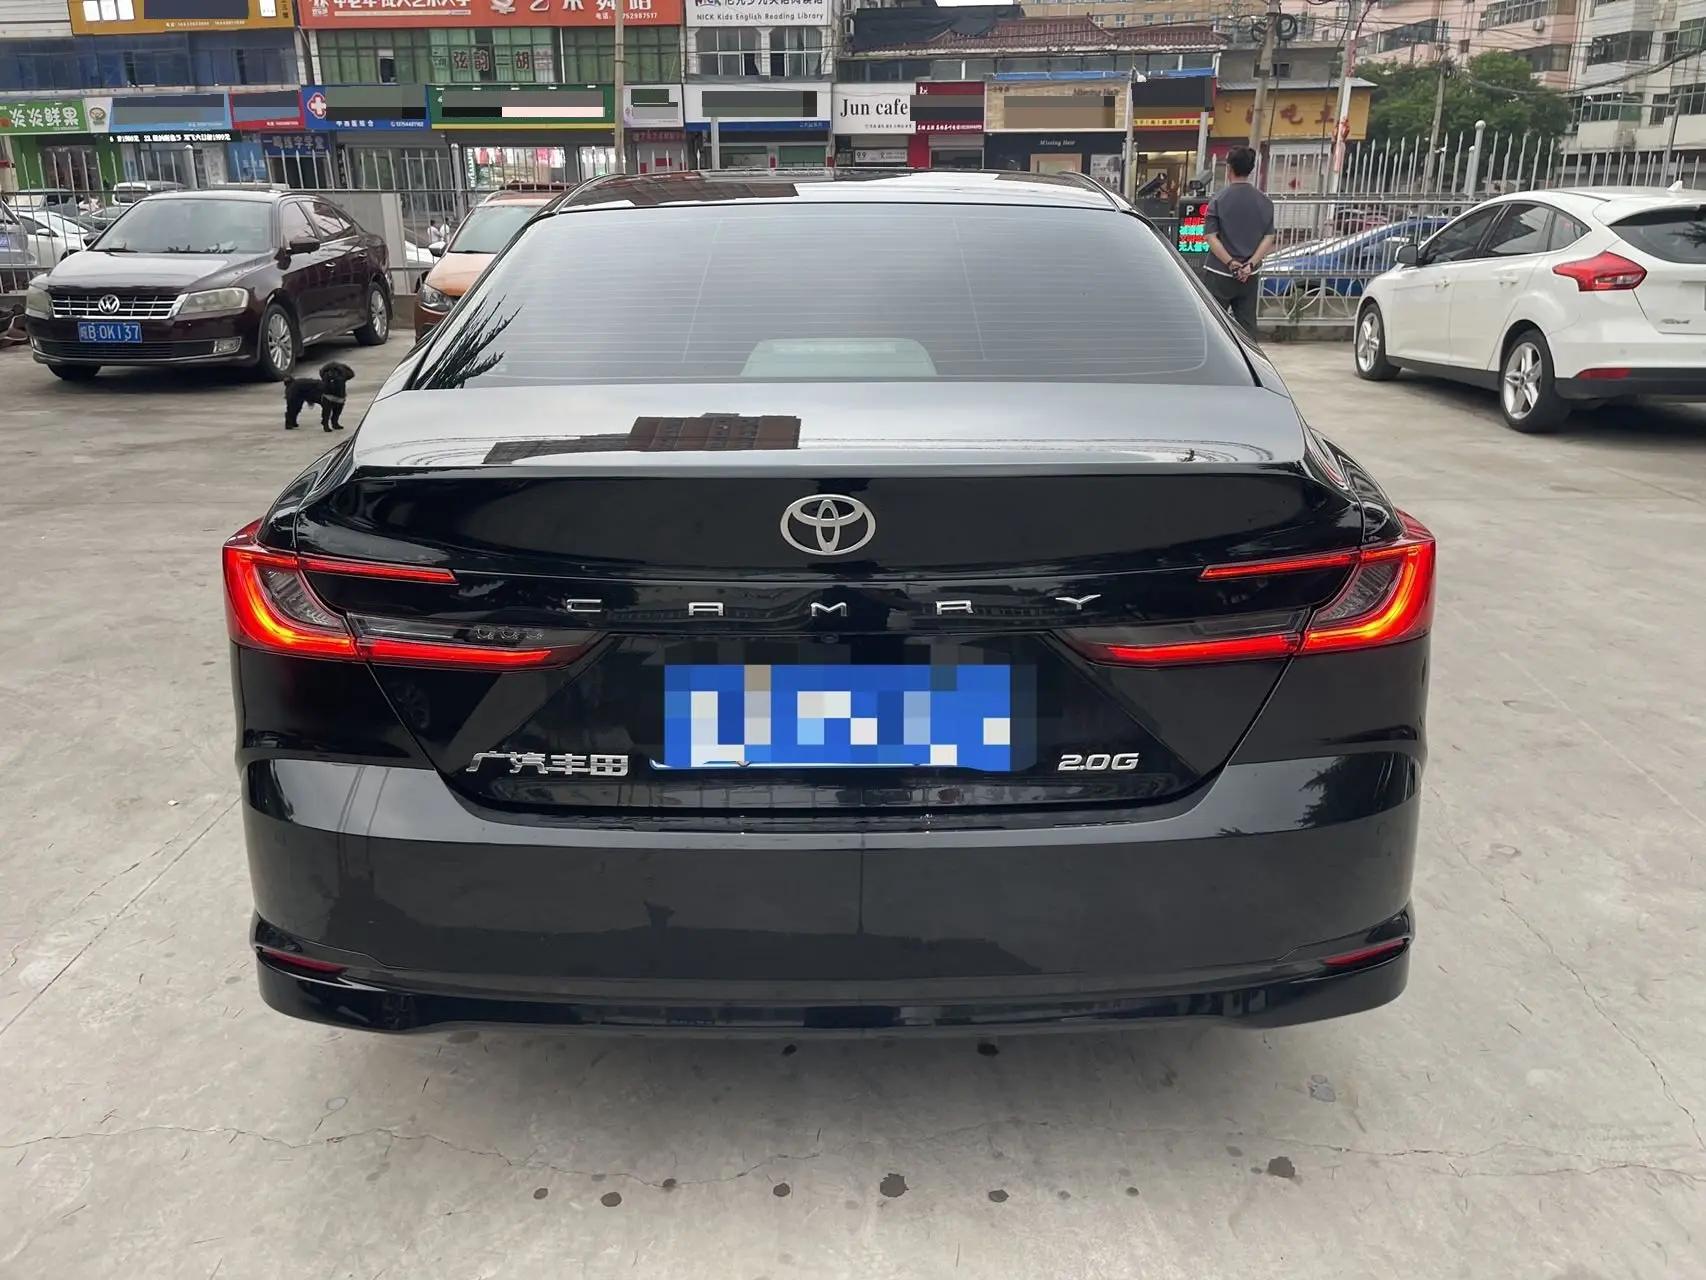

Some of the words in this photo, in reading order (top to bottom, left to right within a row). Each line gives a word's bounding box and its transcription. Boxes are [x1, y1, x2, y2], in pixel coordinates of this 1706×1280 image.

[697, 13, 714, 21] NICK
[717, 13, 733, 21] Kids
[736, 13, 762, 22] English
[765, 13, 795, 21] Reading
[797, 12, 824, 21] Library
[840, 98, 869, 117] Jun
[876, 98, 908, 116] cafe
[566, 594, 1101, 617] CAMRY
[466, 751, 629, 776] 广汽丰田
[1058, 752, 1141, 772] 2.0G
